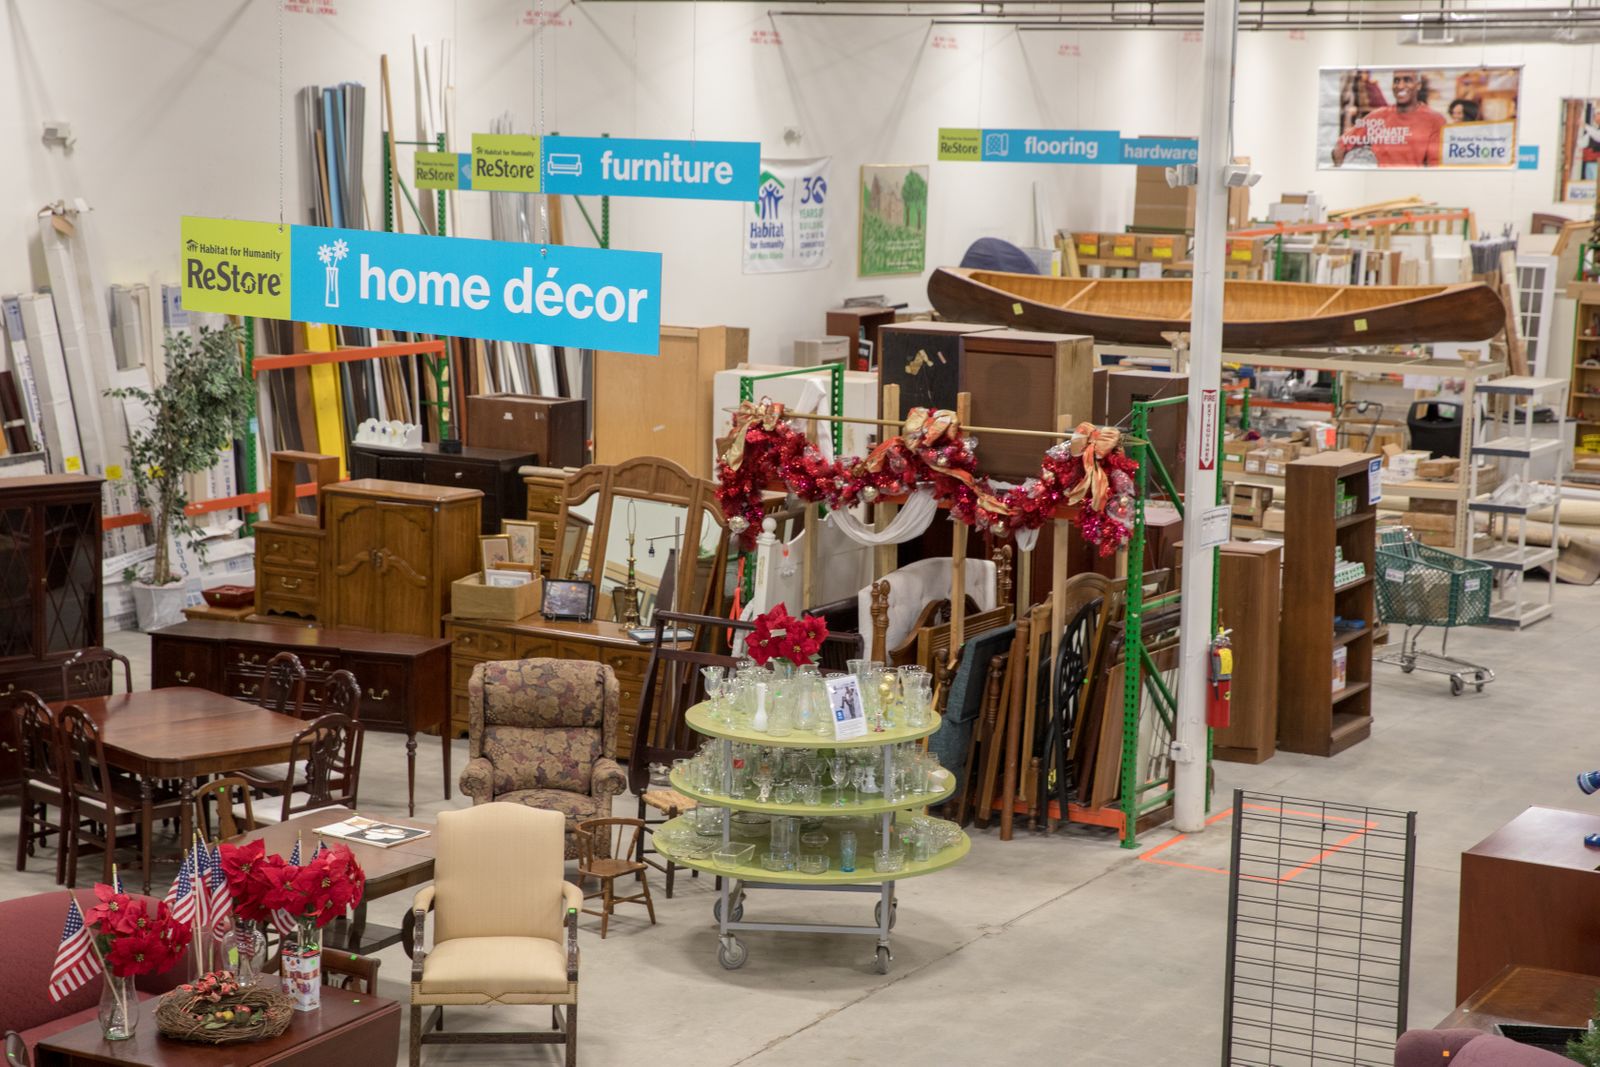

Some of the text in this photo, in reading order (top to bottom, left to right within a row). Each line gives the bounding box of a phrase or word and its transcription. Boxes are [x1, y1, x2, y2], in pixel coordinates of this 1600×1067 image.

[940, 141, 978, 154] ReStore
[1024, 136, 1098, 159] flooring
[1124, 144, 1198, 160] hardware
[1448, 142, 1505, 158] ReStore
[416, 167, 455, 181] ReStore
[476, 158, 535, 179] ReStore
[601, 150, 733, 185] furniture
[800, 175, 827, 204] 30
[750, 221, 784, 238] Habitat
[199, 243, 281, 262] Habitat for Humanity
[187, 258, 281, 296] ReStore
[360, 253, 648, 323] home décor
[1203, 394, 1216, 402] FIRE
